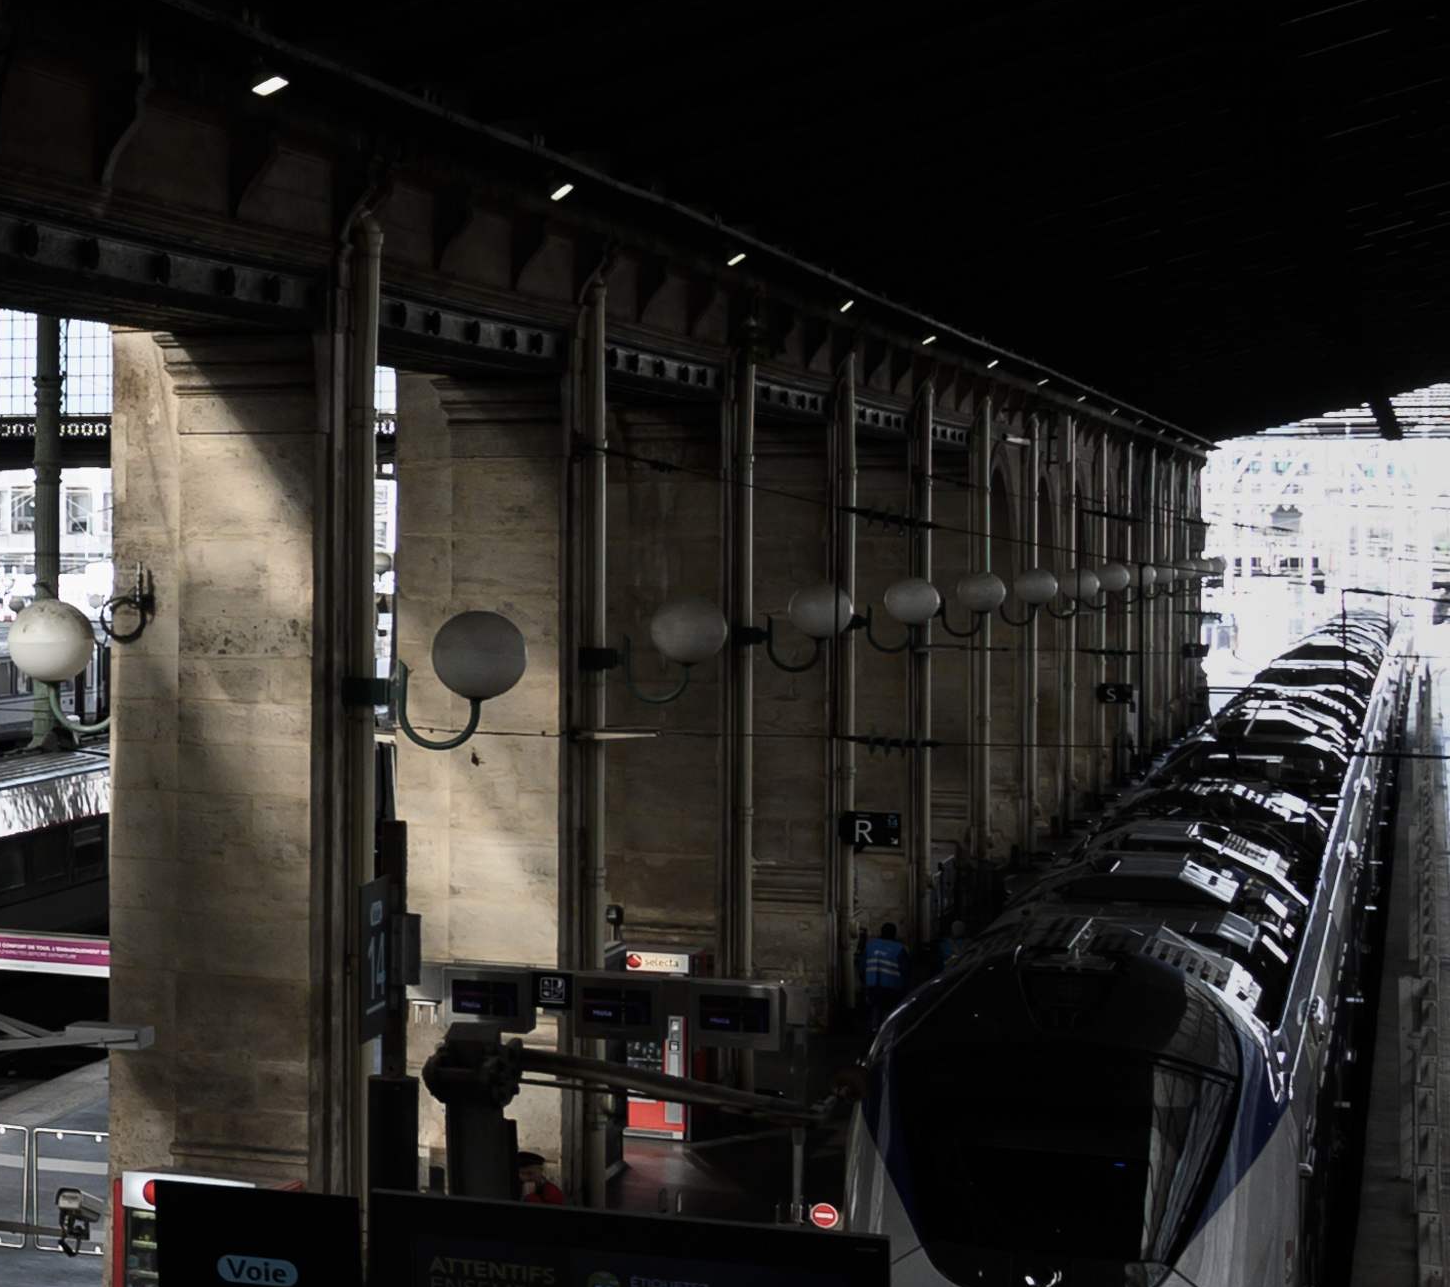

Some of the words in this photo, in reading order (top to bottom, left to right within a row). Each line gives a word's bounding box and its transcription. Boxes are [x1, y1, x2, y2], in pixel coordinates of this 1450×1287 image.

[1105, 688, 1118, 703] S
[854, 819, 873, 845] R
[368, 931, 387, 1001] 14
[644, 957, 679, 968] selecta
[226, 1258, 288, 1284] Voie
[428, 1256, 555, 1286] ATTENTIFS
